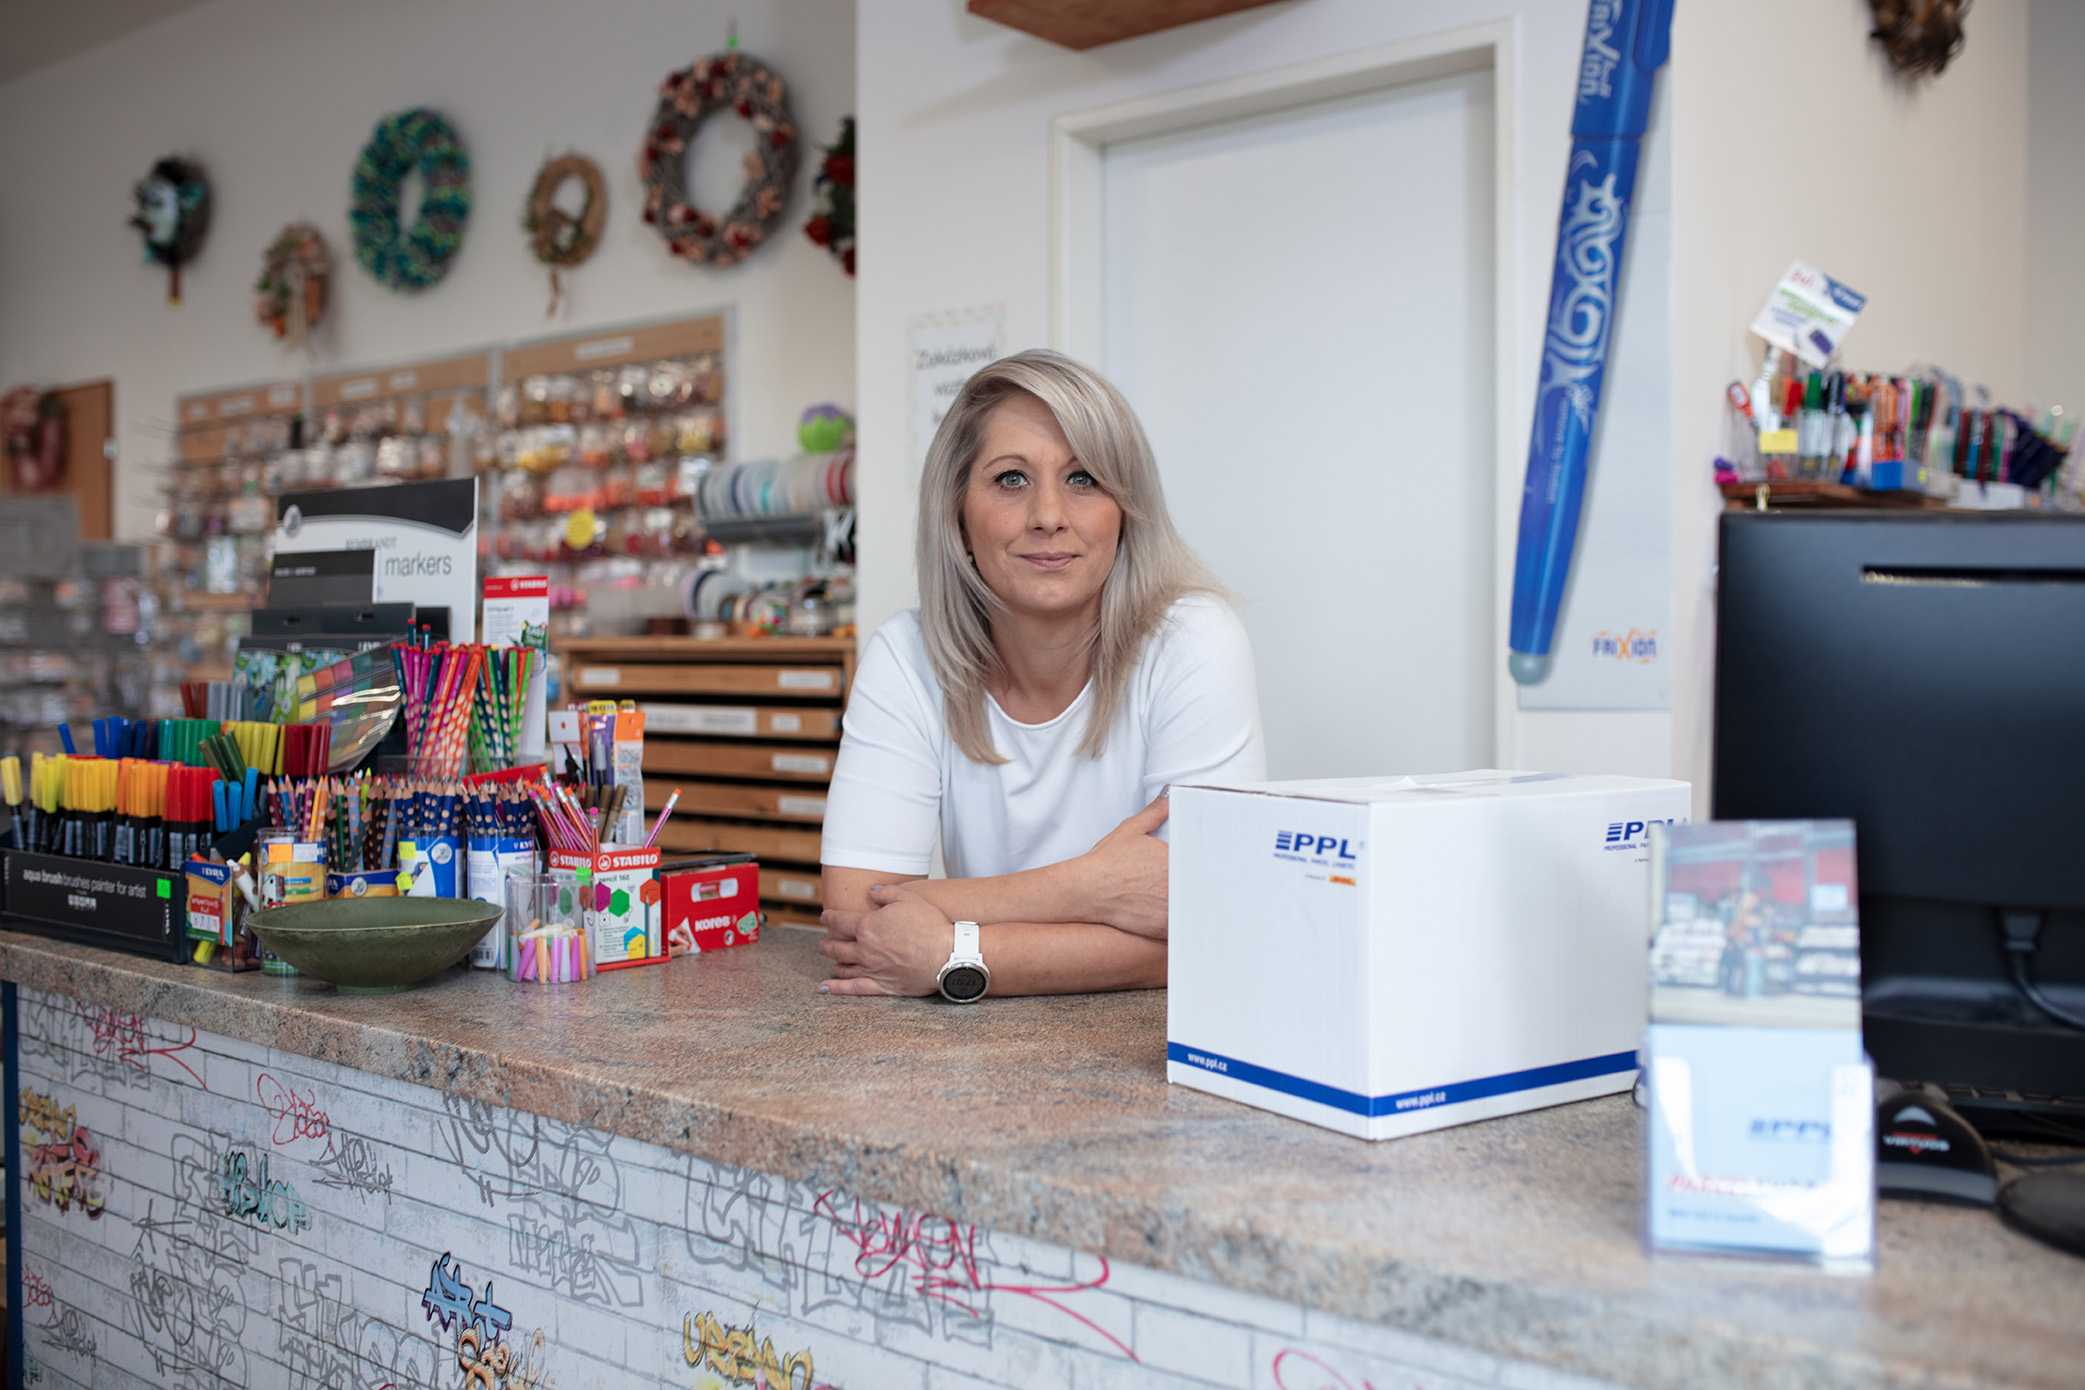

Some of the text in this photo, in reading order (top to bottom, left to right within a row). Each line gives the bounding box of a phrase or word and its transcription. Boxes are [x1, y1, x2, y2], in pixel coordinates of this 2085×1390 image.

[385, 550, 453, 577] markers
[1293, 832, 1357, 860] PPL
[560, 855, 592, 869] STABILO
[612, 854, 659, 868] STABILO
[205, 867, 224, 878] LYRA
[23, 869, 41, 883] aqua
[41, 869, 62, 885] brush
[62, 873, 91, 890] brushes
[91, 879, 115, 893] painter
[116, 880, 127, 895] for
[127, 884, 146, 898] artist
[695, 915, 731, 932] Kores
[1187, 1052, 1228, 1072] www.ppl.cz
[1395, 1090, 1447, 1110] www.ppl.cz
